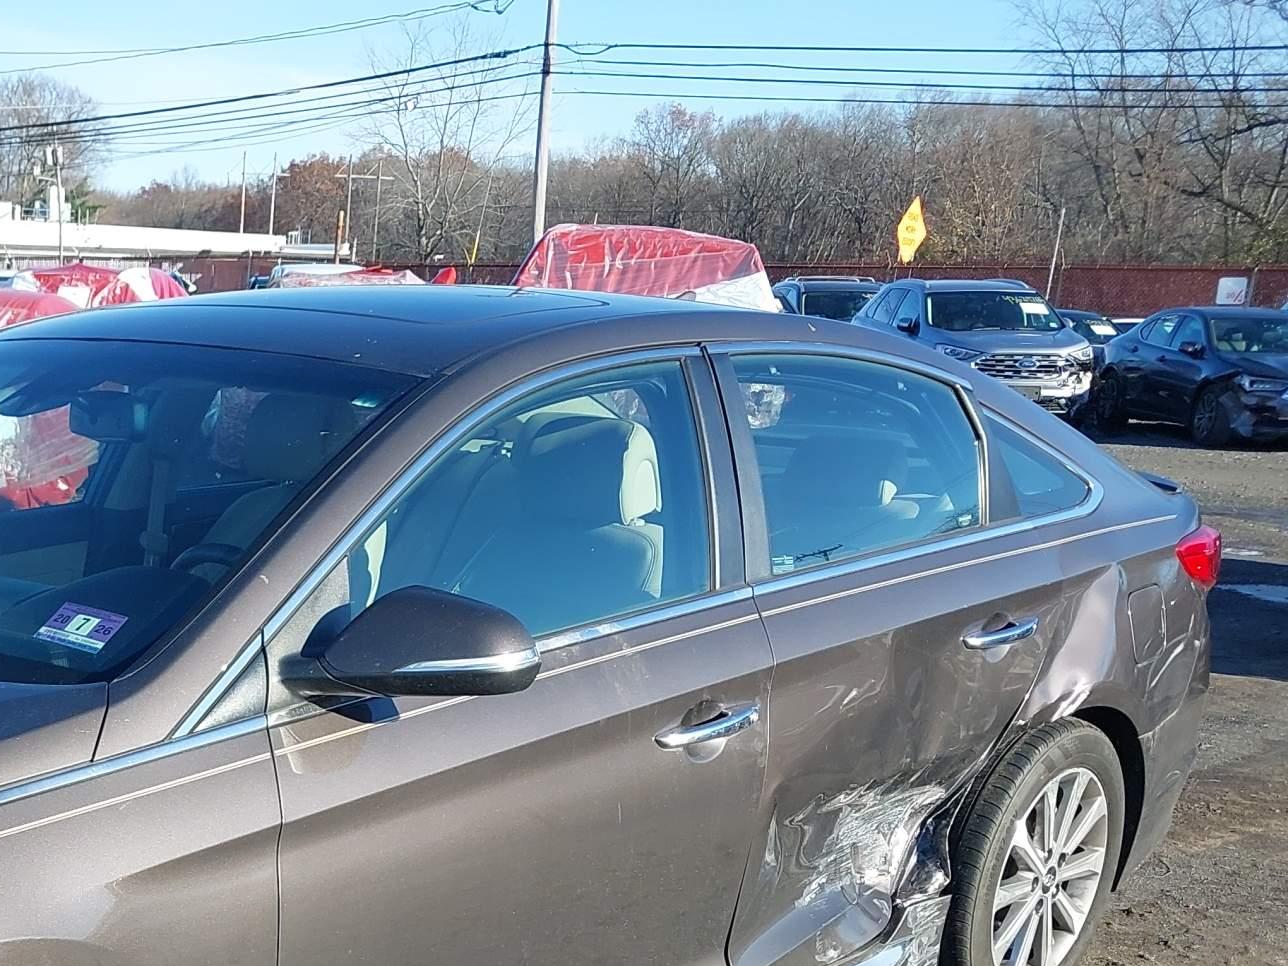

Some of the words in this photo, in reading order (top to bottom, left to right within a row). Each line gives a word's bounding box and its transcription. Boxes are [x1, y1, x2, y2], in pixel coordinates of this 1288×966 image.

[53, 613, 71, 625] 20
[75, 617, 91, 632] 7
[94, 624, 114, 636] 26
